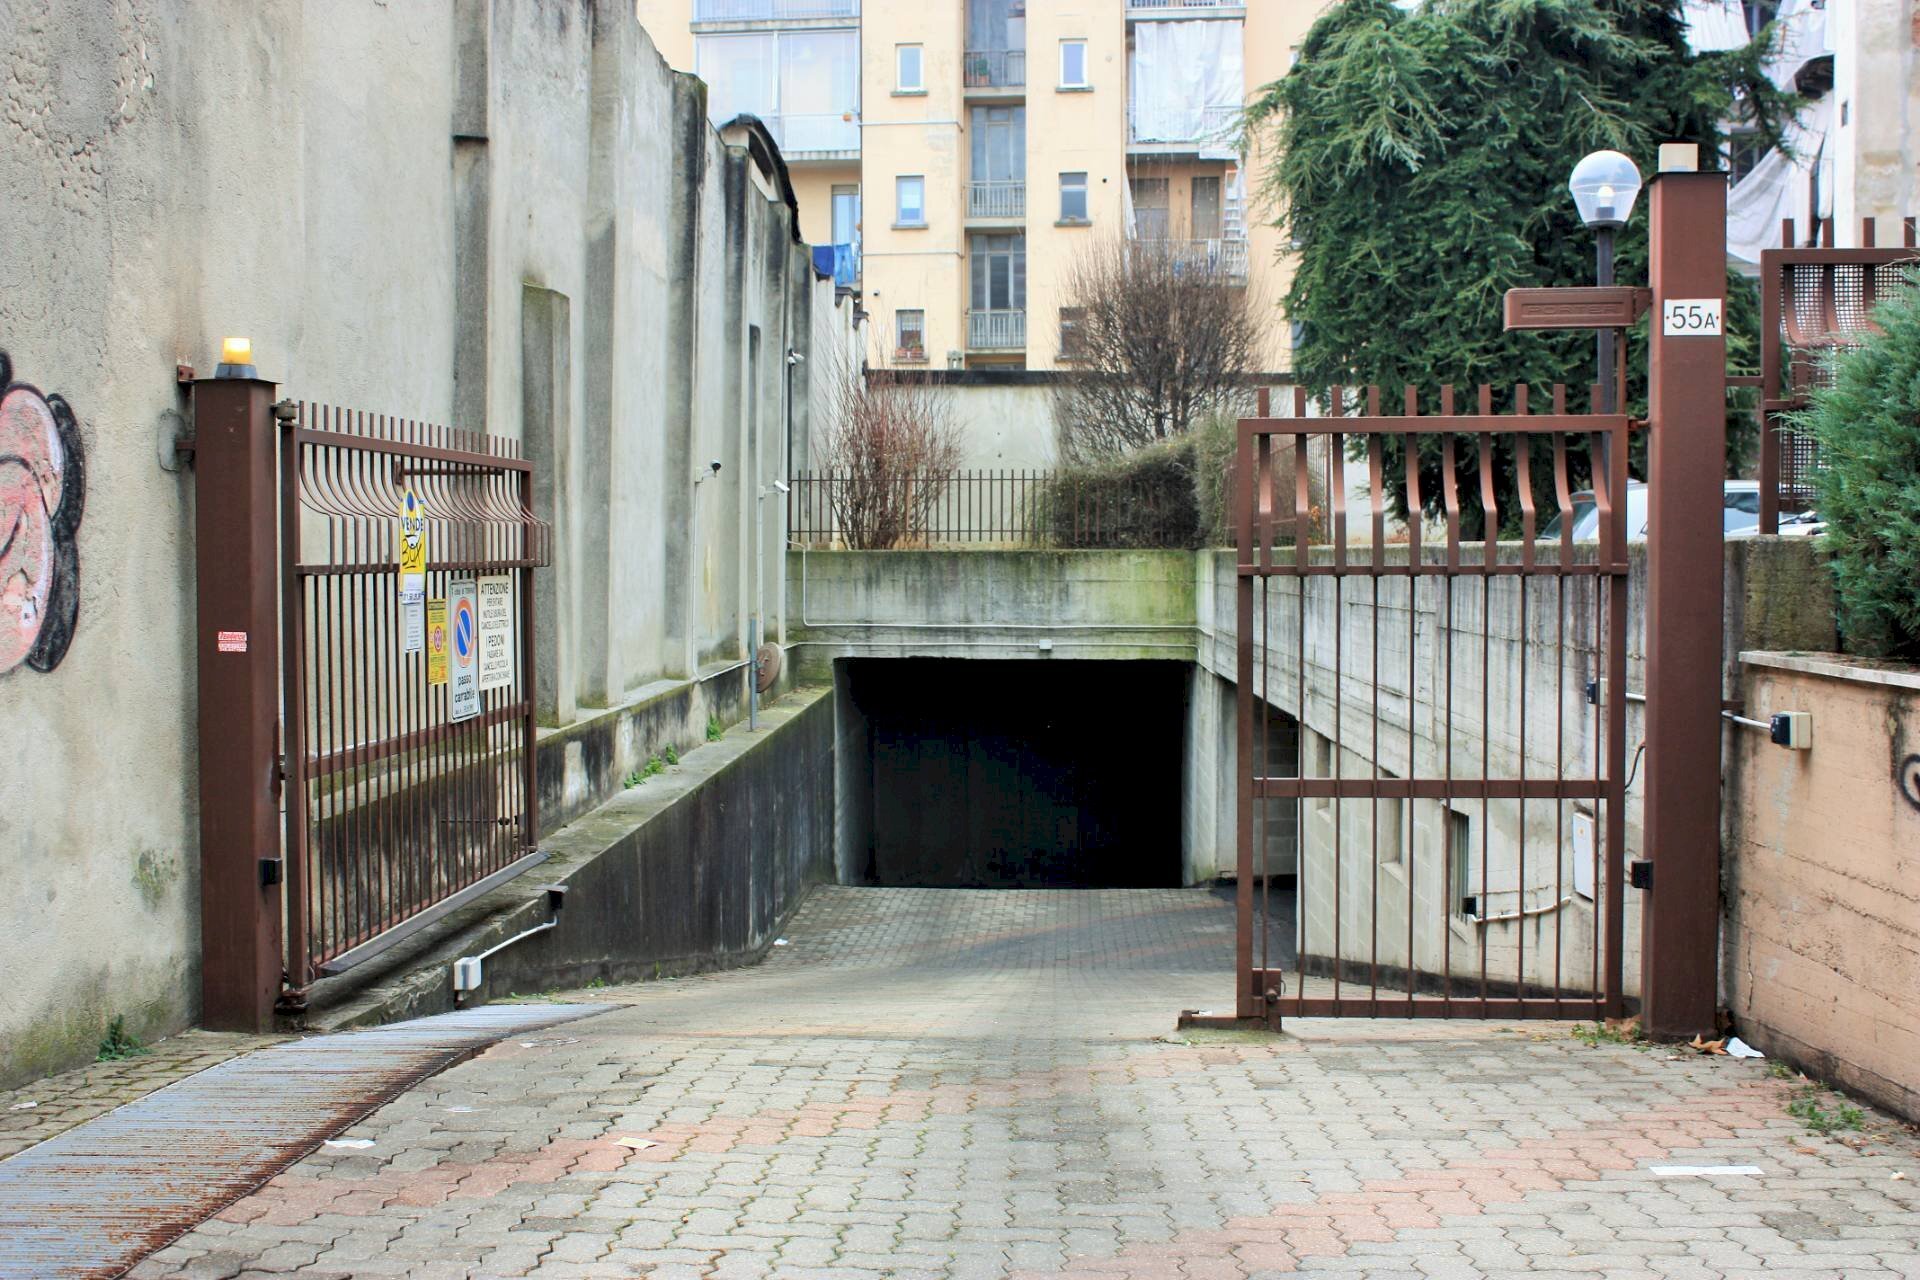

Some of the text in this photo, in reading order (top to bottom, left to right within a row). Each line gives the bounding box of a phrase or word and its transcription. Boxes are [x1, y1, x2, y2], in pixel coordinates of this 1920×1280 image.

[1671, 305, 1716, 329] 55A
[401, 516, 424, 532] VENDE
[481, 582, 509, 595] ATTENZIONE
[458, 674, 471, 686] passo
[455, 687, 475, 703] carrabile
